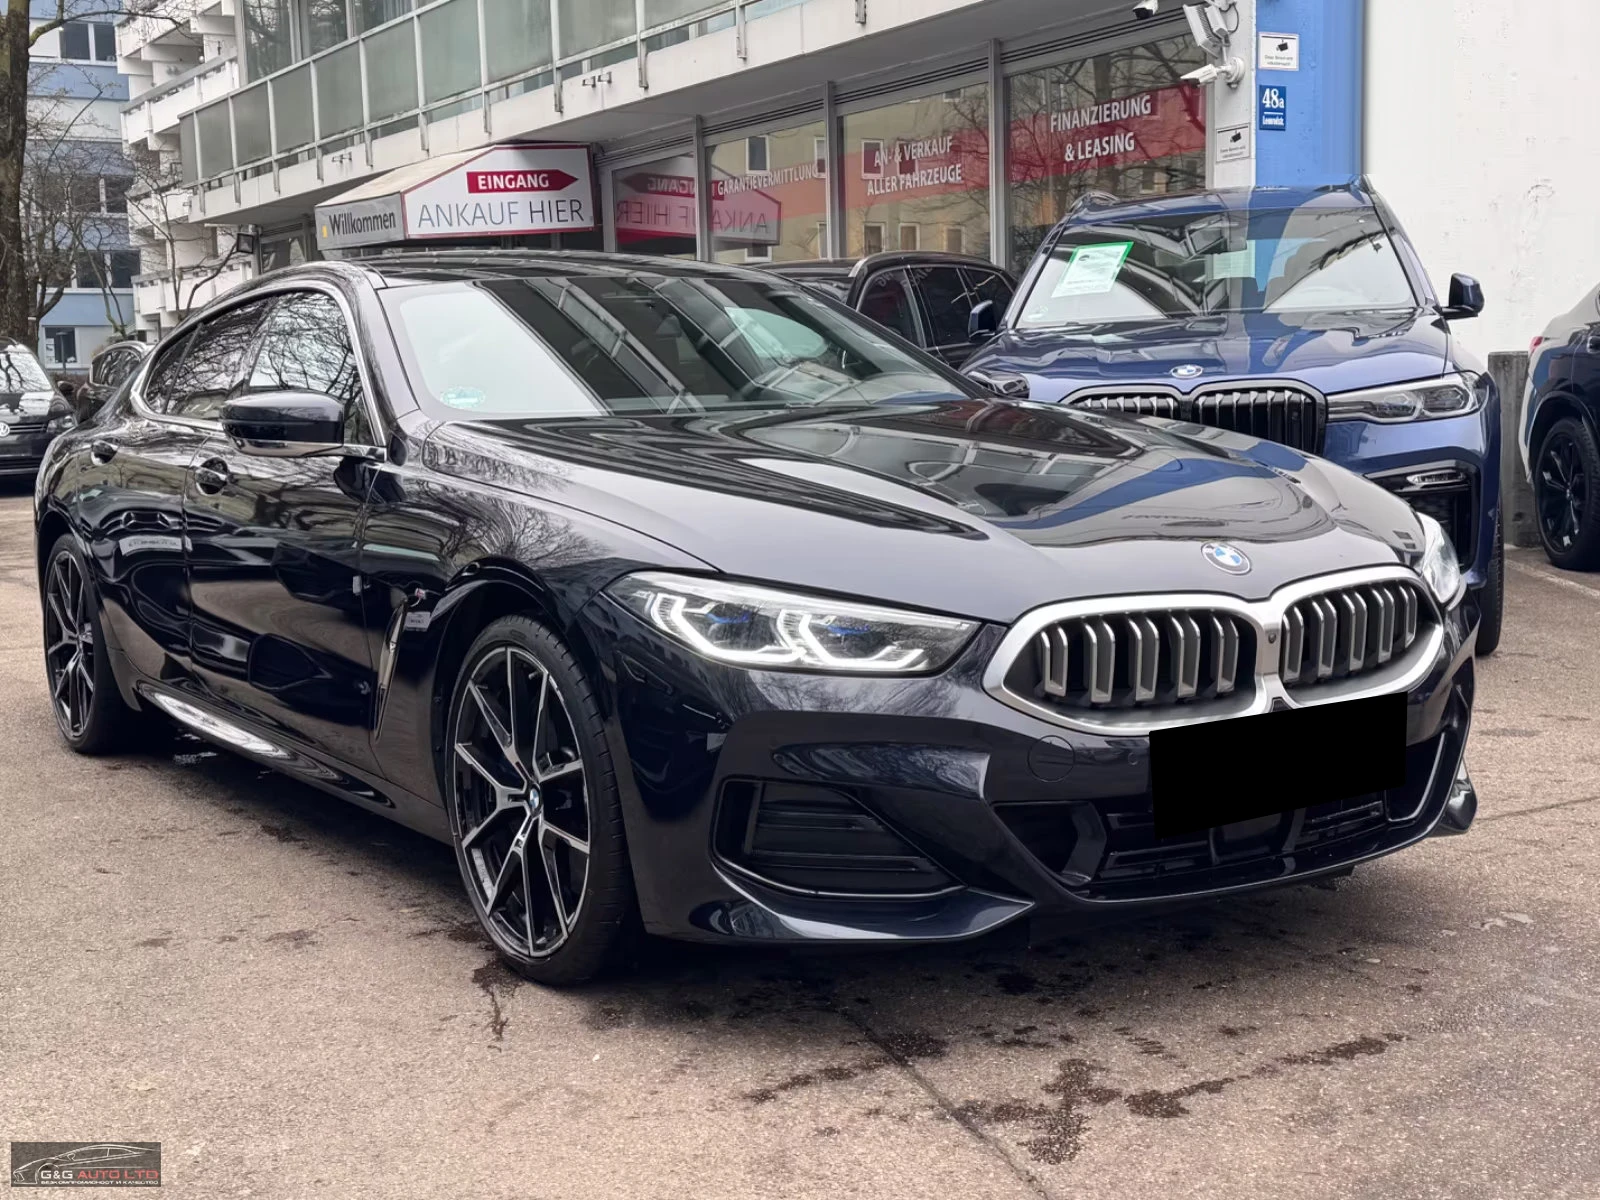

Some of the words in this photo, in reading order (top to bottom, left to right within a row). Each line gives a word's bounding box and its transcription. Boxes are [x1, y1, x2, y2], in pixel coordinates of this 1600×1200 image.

[1050, 95, 1151, 132] FINANZIERUNG
[1262, 88, 1285, 109] 48a
[903, 136, 953, 162] VERKAUF
[1064, 147, 1074, 162] &
[1077, 131, 1135, 159] LEASING
[477, 173, 550, 191] EINGANG
[717, 163, 818, 196] GARANTIEVERMITTLUNG
[867, 178, 898, 196] ALLER
[899, 163, 963, 191] FAHRZEUGE
[328, 209, 397, 235] Willkommen
[417, 200, 520, 229] ANKAUF
[528, 198, 585, 224] HIER
